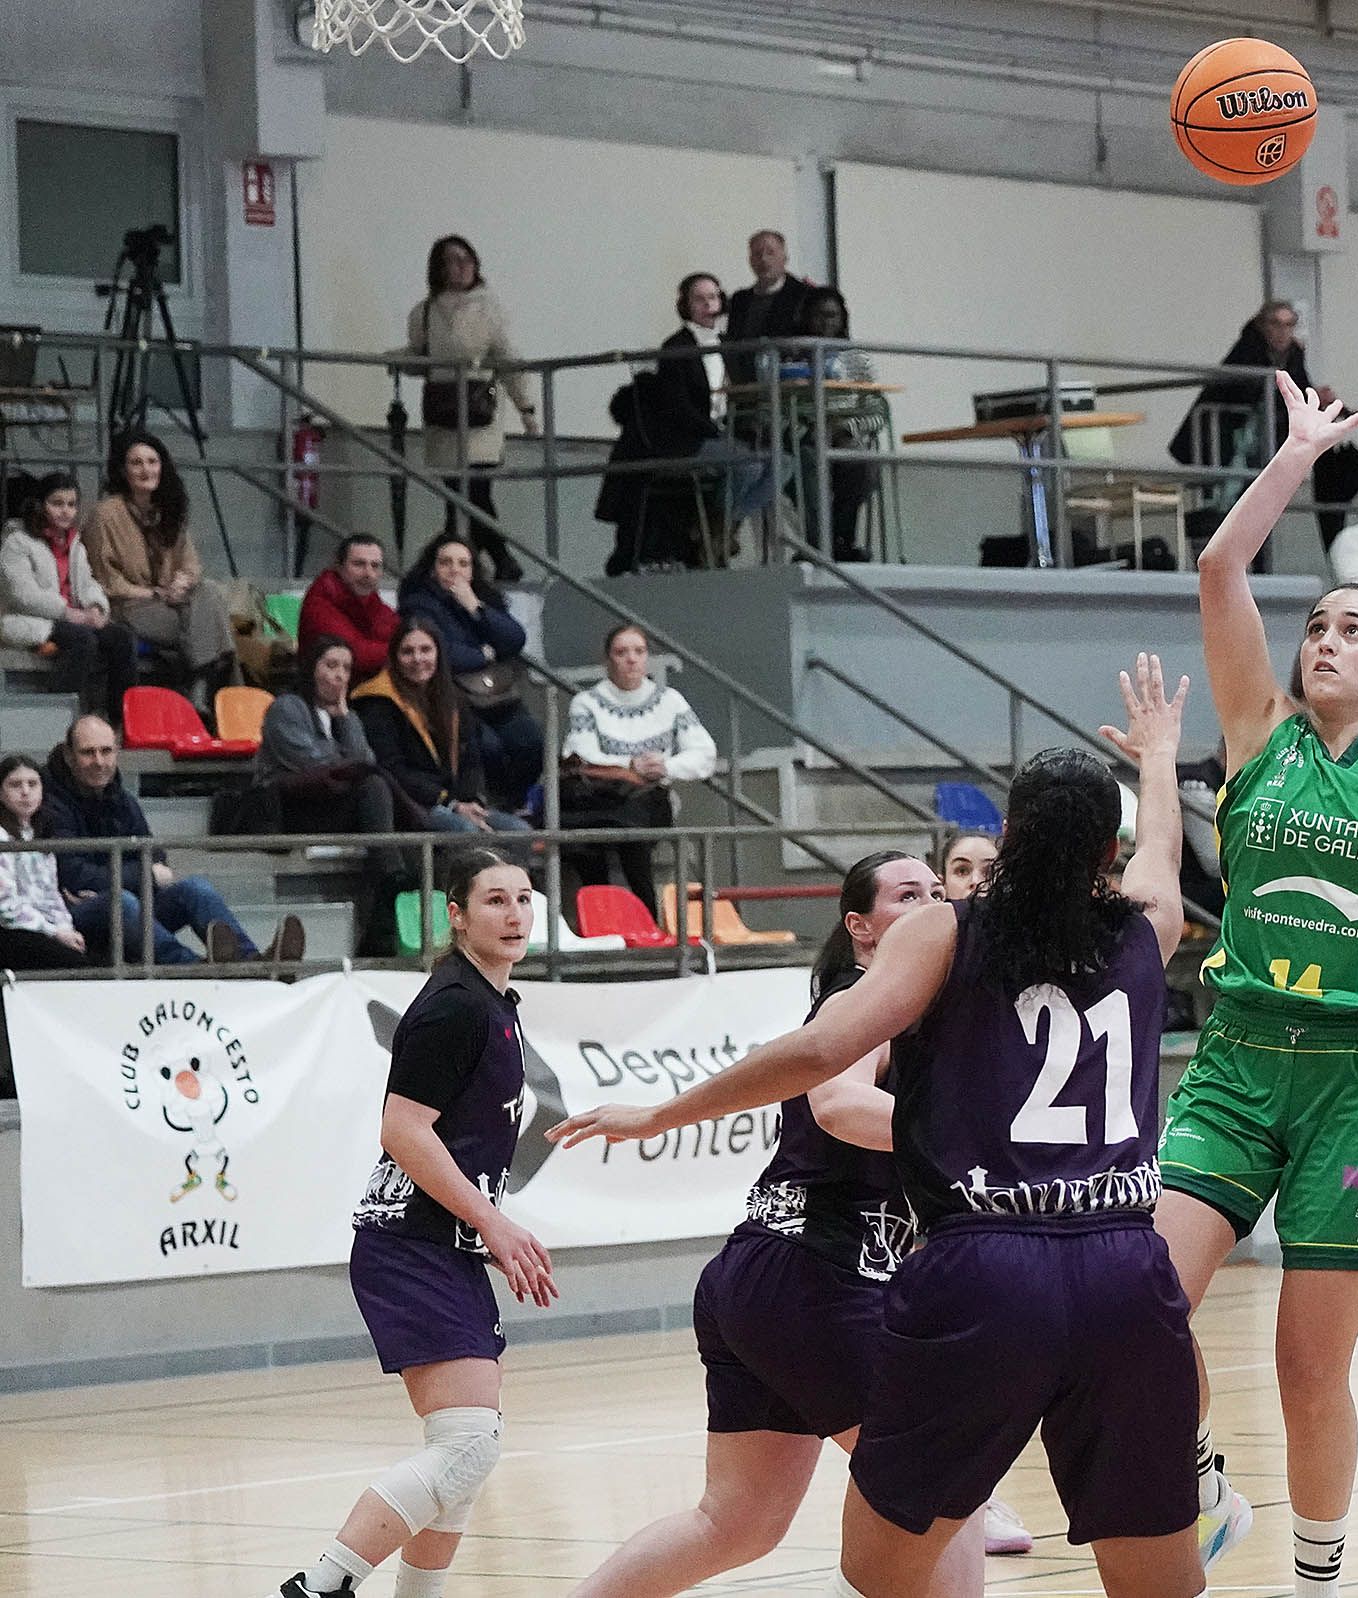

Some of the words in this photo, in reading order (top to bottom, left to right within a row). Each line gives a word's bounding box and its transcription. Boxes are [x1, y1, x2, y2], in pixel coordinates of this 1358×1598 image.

[1215, 85, 1309, 120] Wilson
[1283, 827, 1312, 849] DE
[1268, 958, 1324, 999] 14
[120, 1042, 141, 1111] CLUB
[138, 999, 259, 1104] BALONCESTO
[1009, 982, 1141, 1145] 21
[159, 1218, 239, 1257] ARXIL
